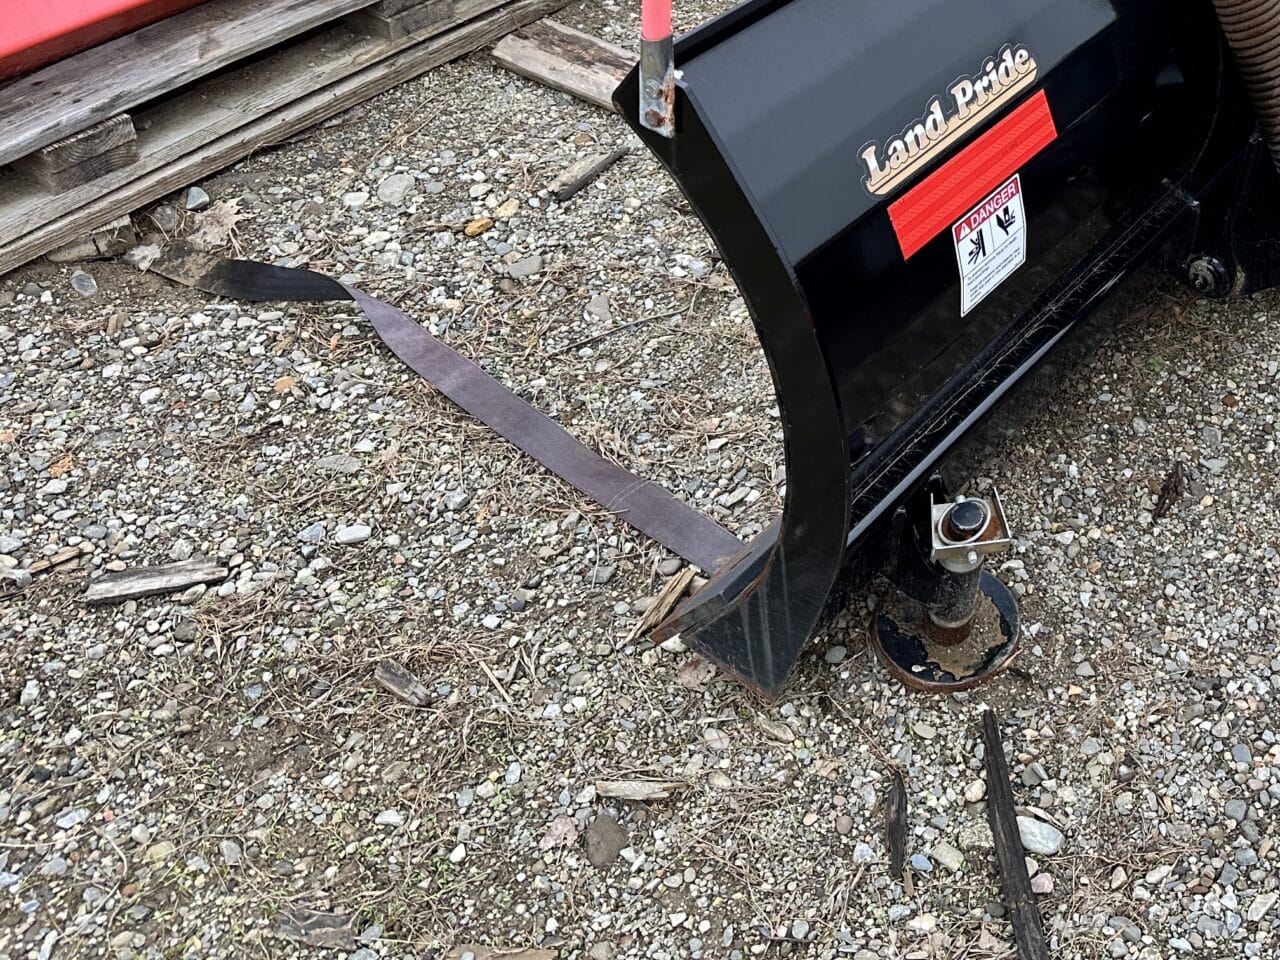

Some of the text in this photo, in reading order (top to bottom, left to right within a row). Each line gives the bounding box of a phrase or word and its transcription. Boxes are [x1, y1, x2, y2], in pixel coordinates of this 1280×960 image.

[861, 48, 1031, 187] Land Pride
[970, 183, 1017, 229] DANGER
